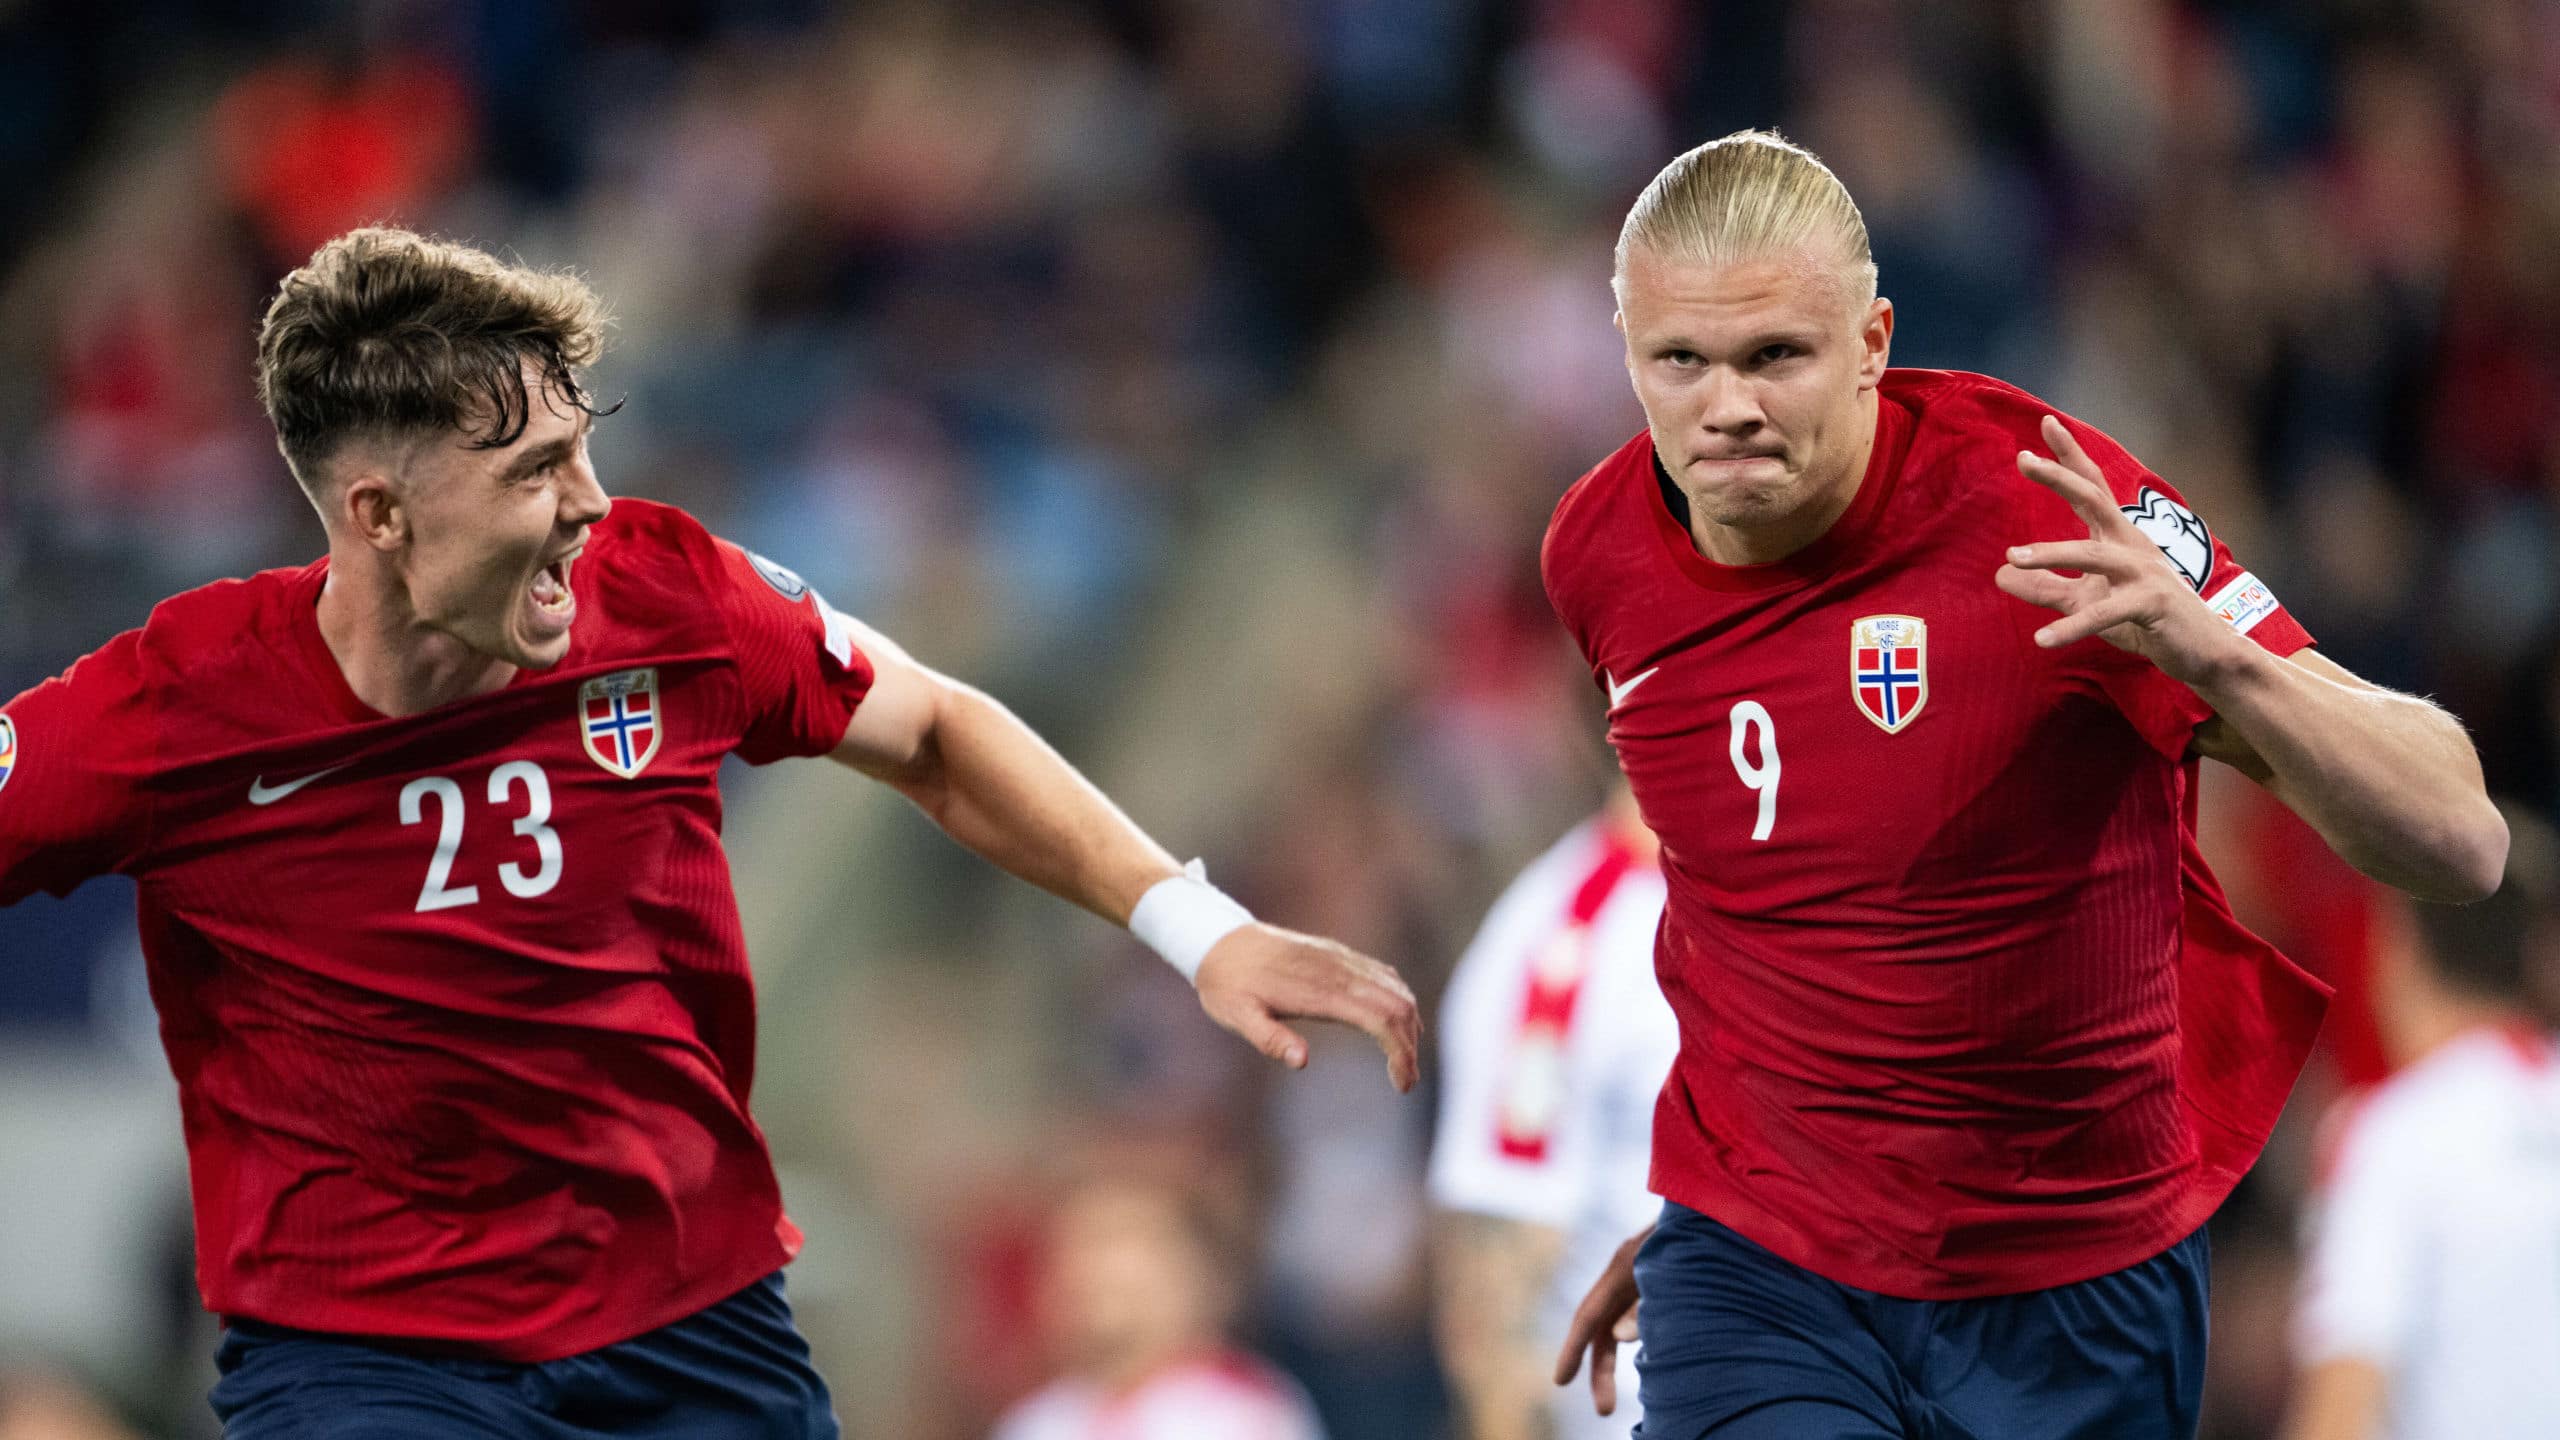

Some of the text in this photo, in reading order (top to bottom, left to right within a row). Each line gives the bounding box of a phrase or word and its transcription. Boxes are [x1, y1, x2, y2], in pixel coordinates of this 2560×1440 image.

[1876, 620, 1900, 631] NORGE
[399, 760, 564, 912] 23
[1729, 700, 1782, 841] 9
